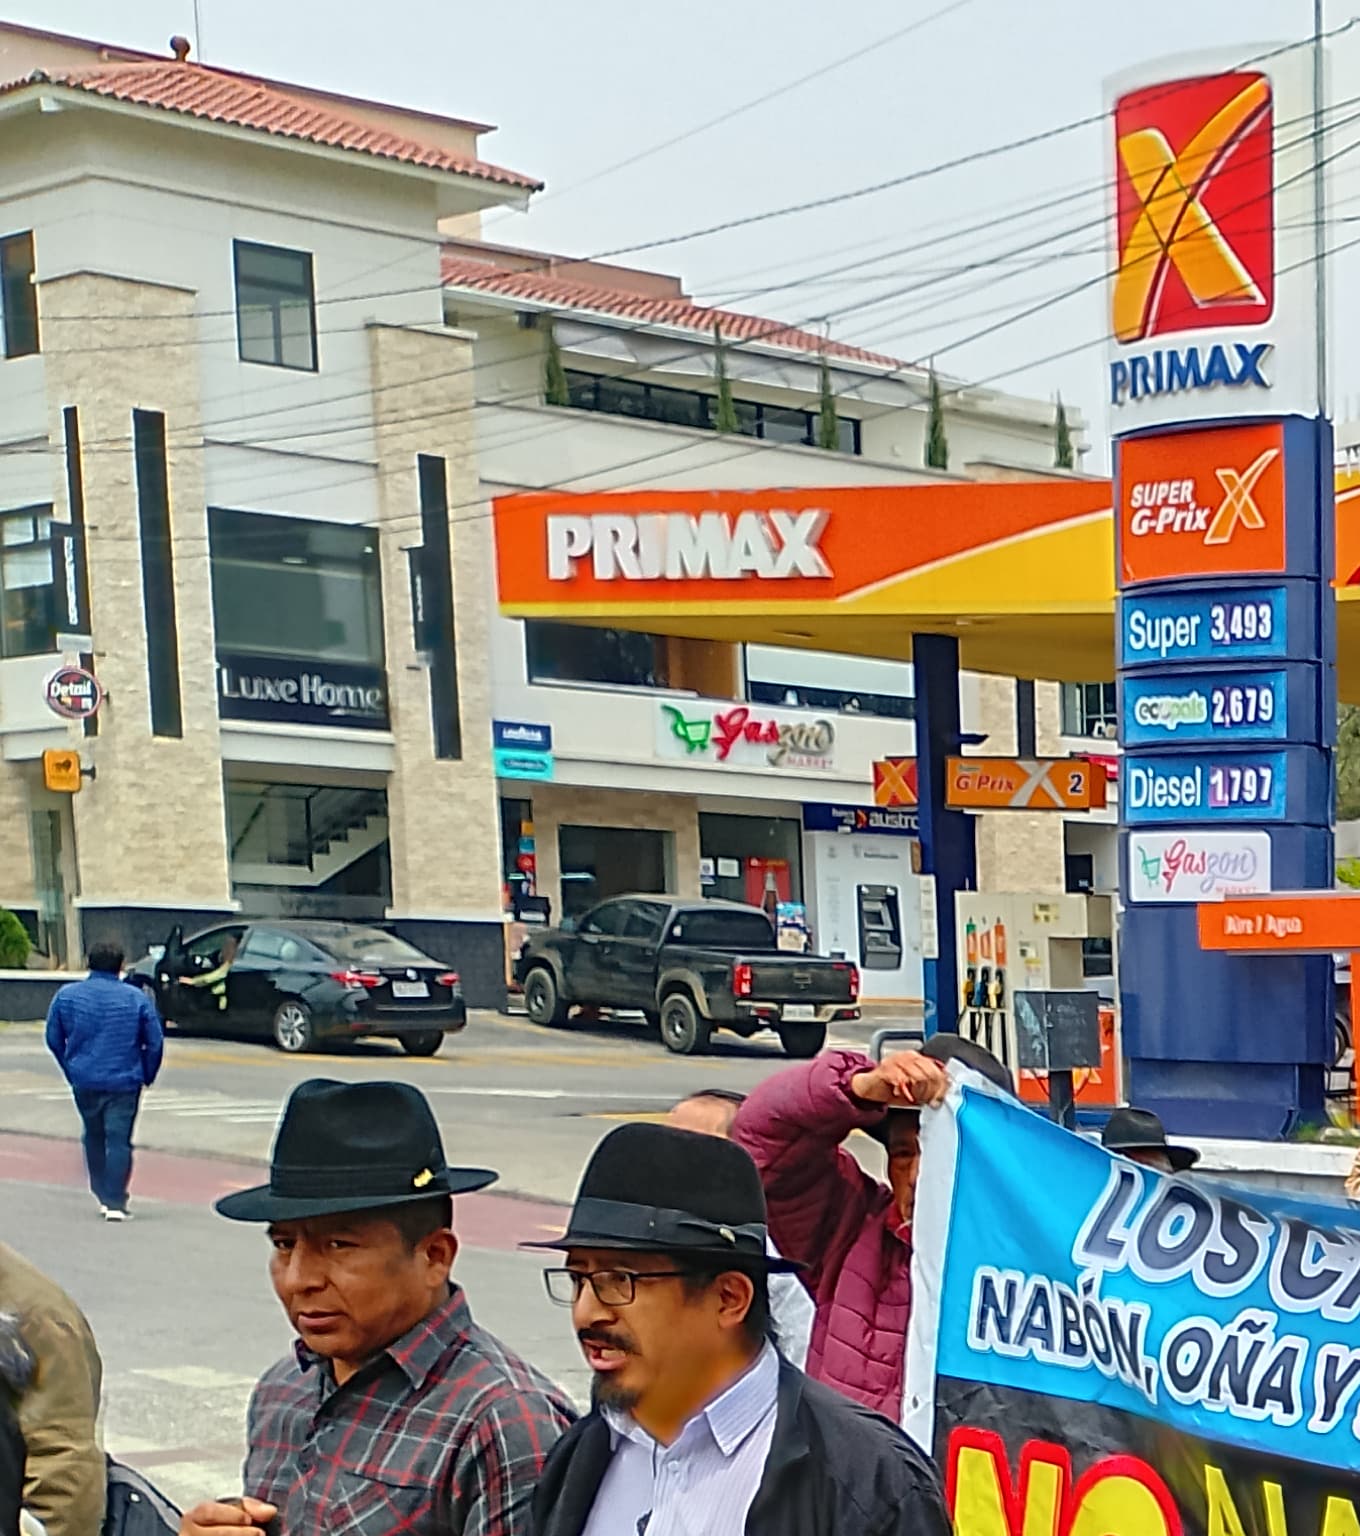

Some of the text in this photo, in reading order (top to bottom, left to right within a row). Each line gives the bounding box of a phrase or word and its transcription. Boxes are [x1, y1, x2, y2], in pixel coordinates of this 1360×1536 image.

[1109, 343, 1275, 407] PRIMAX
[1130, 478, 1195, 508] SUPER
[1130, 502, 1210, 536] G-Prix
[547, 508, 835, 581] PRIMAX
[1129, 610, 1201, 658] Super
[220, 667, 386, 710] Luxe Home
[1069, 773, 1083, 794] 2
[1129, 764, 1202, 808] Diesel
[1081, 1161, 1273, 1292] LOS
[974, 1272, 1158, 1396] NABÓN,
[1164, 1317, 1300, 1416] OÑA
